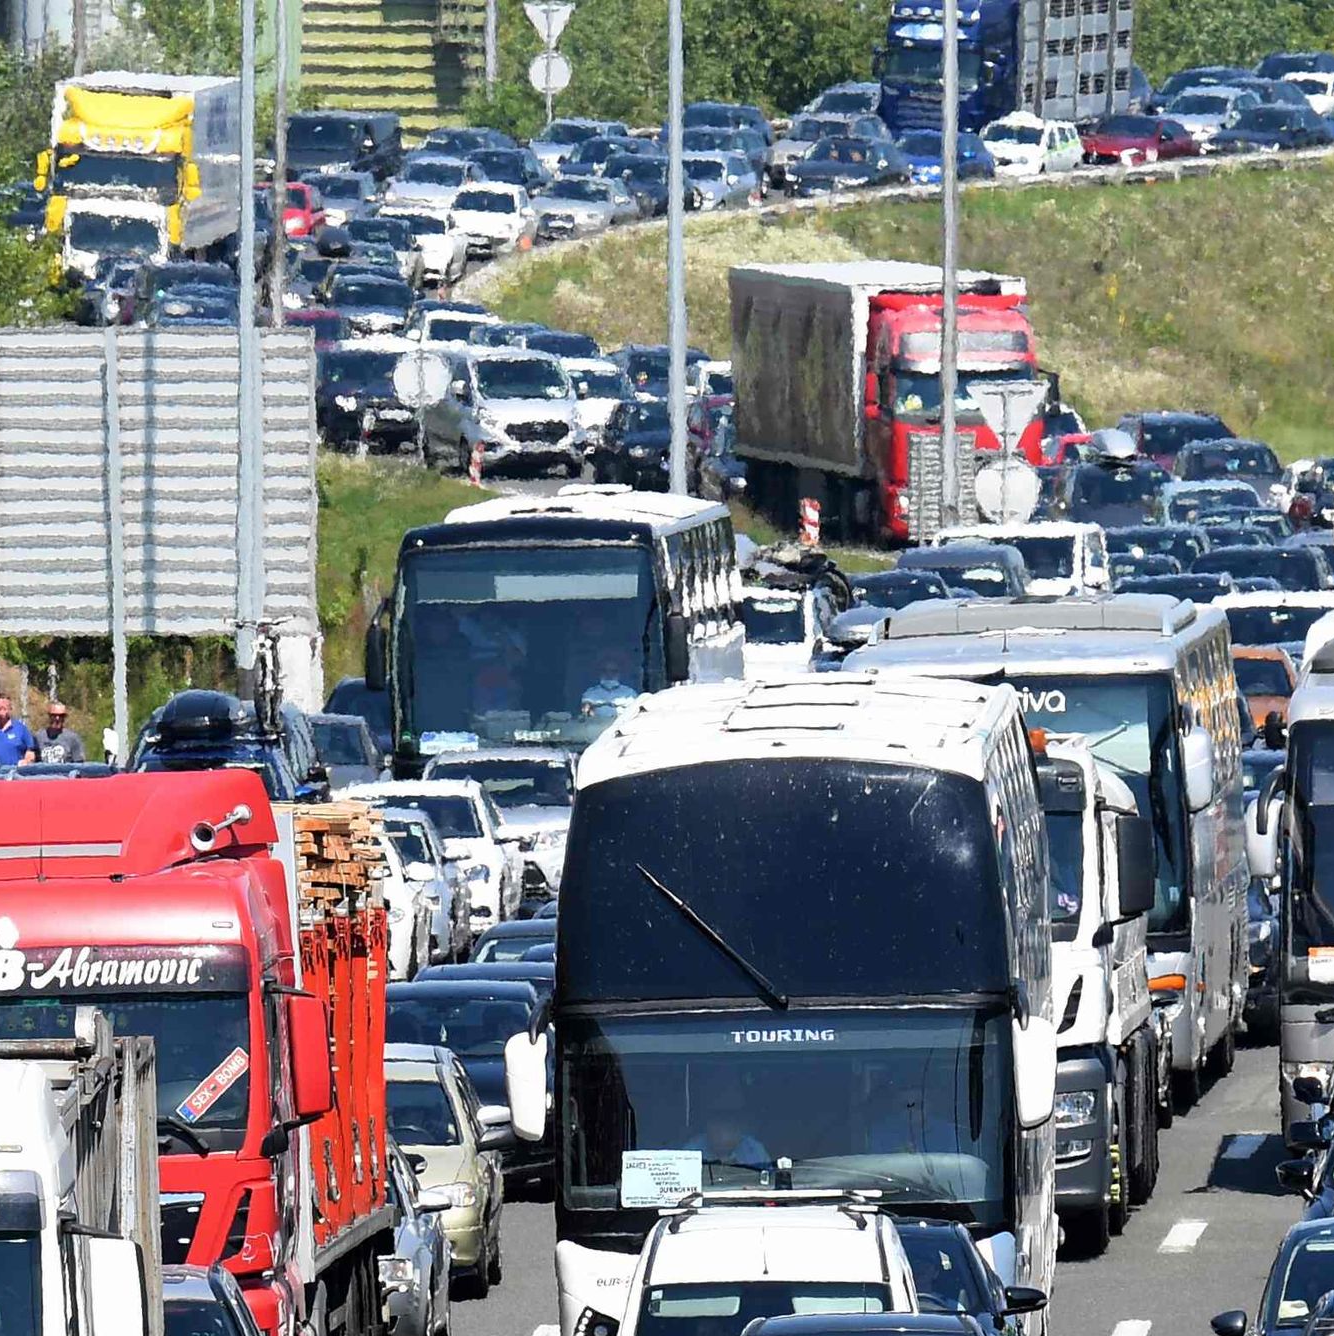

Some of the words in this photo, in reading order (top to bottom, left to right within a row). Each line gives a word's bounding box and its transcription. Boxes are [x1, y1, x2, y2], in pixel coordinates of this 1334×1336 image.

[730, 1029, 835, 1043] TOURING
[191, 1087, 213, 1109] SEX
[215, 1055, 245, 1085] BOMB
